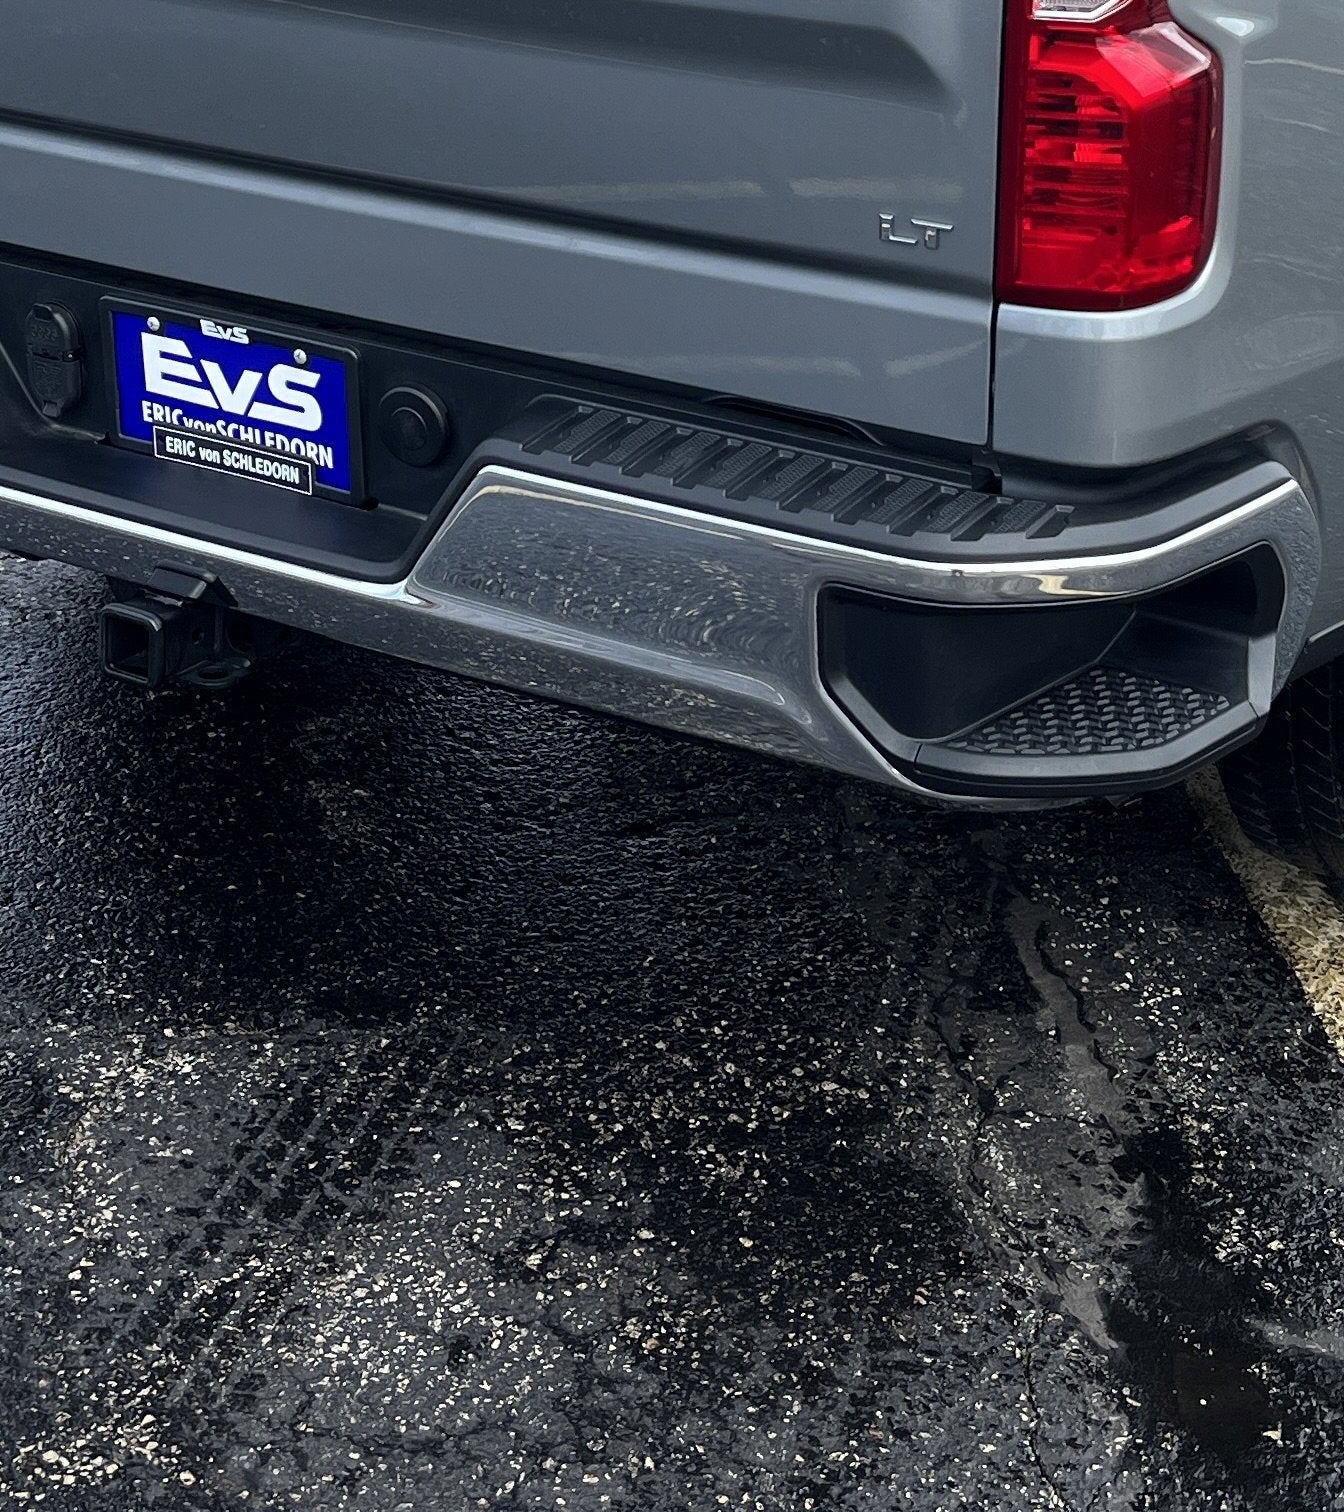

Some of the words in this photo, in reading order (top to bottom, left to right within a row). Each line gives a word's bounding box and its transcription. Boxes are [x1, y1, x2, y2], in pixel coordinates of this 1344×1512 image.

[878, 212, 955, 250] LT
[165, 435, 196, 458] ERIC
[199, 445, 221, 464] von
[222, 449, 300, 485] SCHLEDORN
